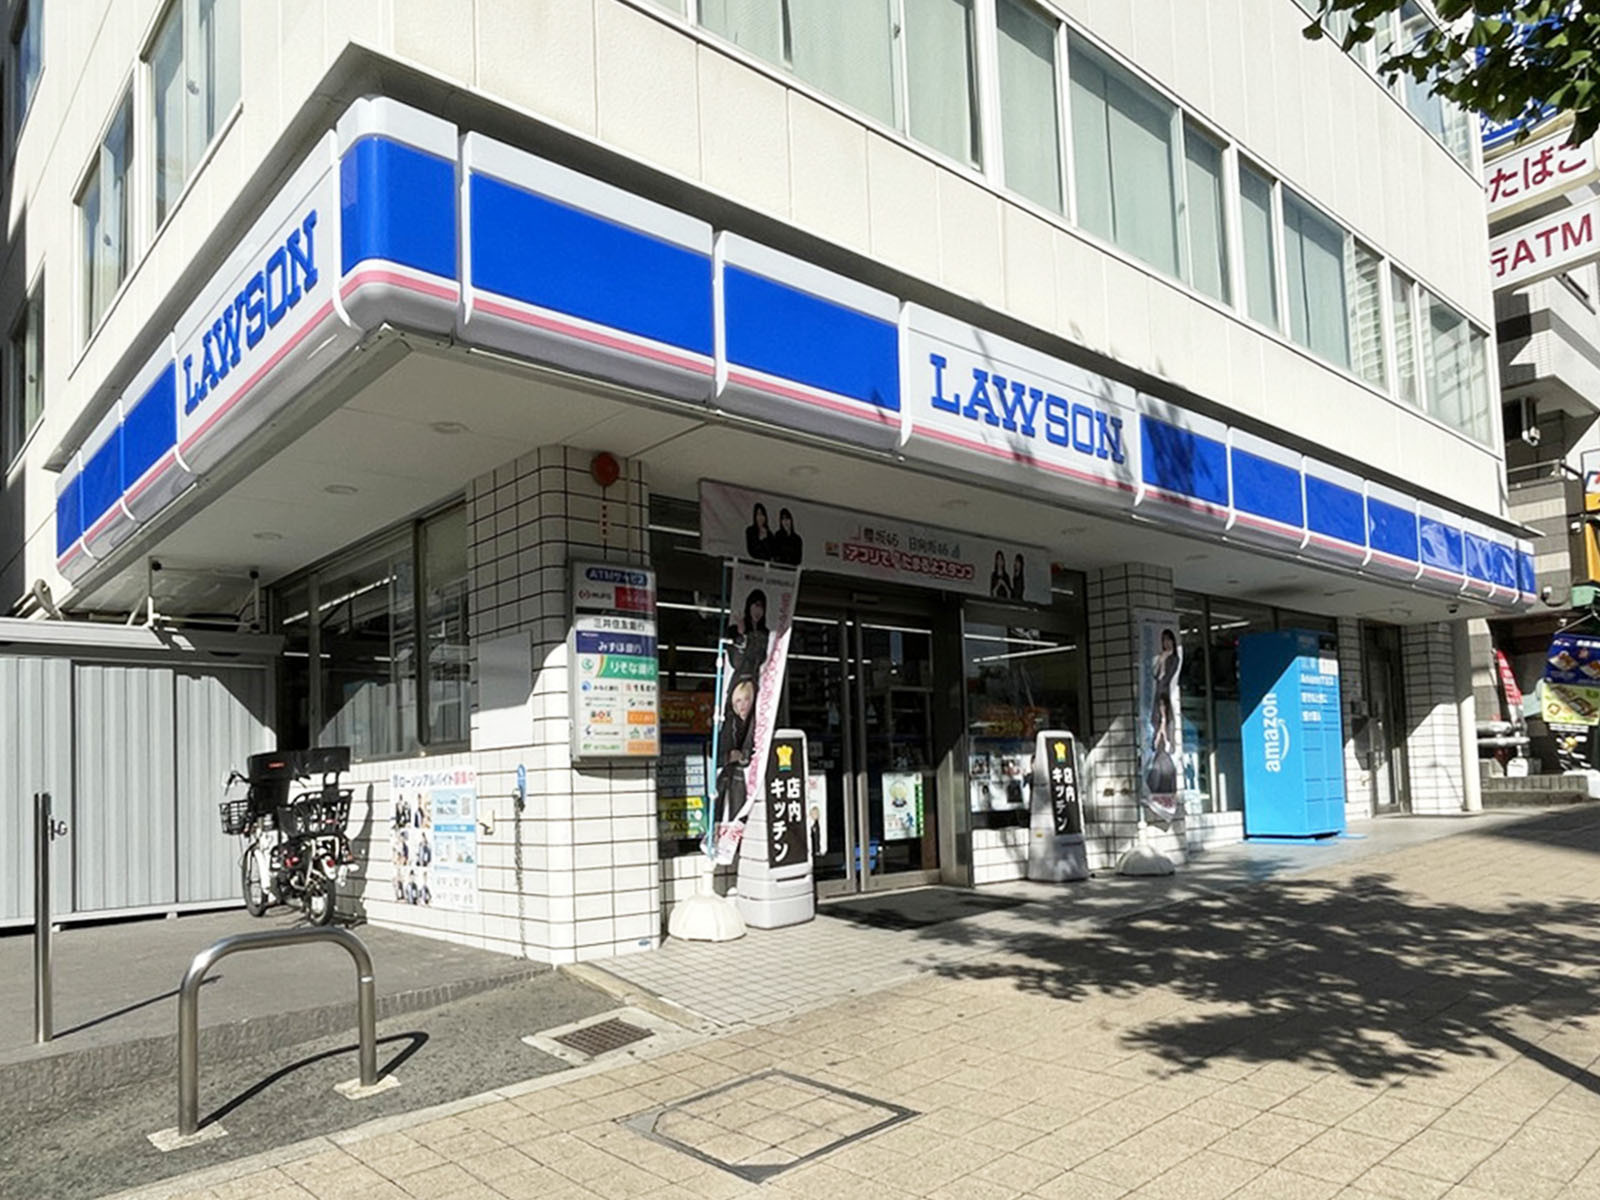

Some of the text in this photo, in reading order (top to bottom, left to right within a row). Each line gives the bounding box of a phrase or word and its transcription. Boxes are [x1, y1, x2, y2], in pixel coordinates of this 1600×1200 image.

[1489, 143, 1587, 203] たばこ
[183, 209, 318, 416] LAWSON
[929, 352, 1125, 465] LAWSON
[1262, 692, 1281, 773] amazon
[770, 777, 789, 863] キッチン
[786, 777, 802, 823] 店内
[1052, 767, 1069, 831] キッチン
